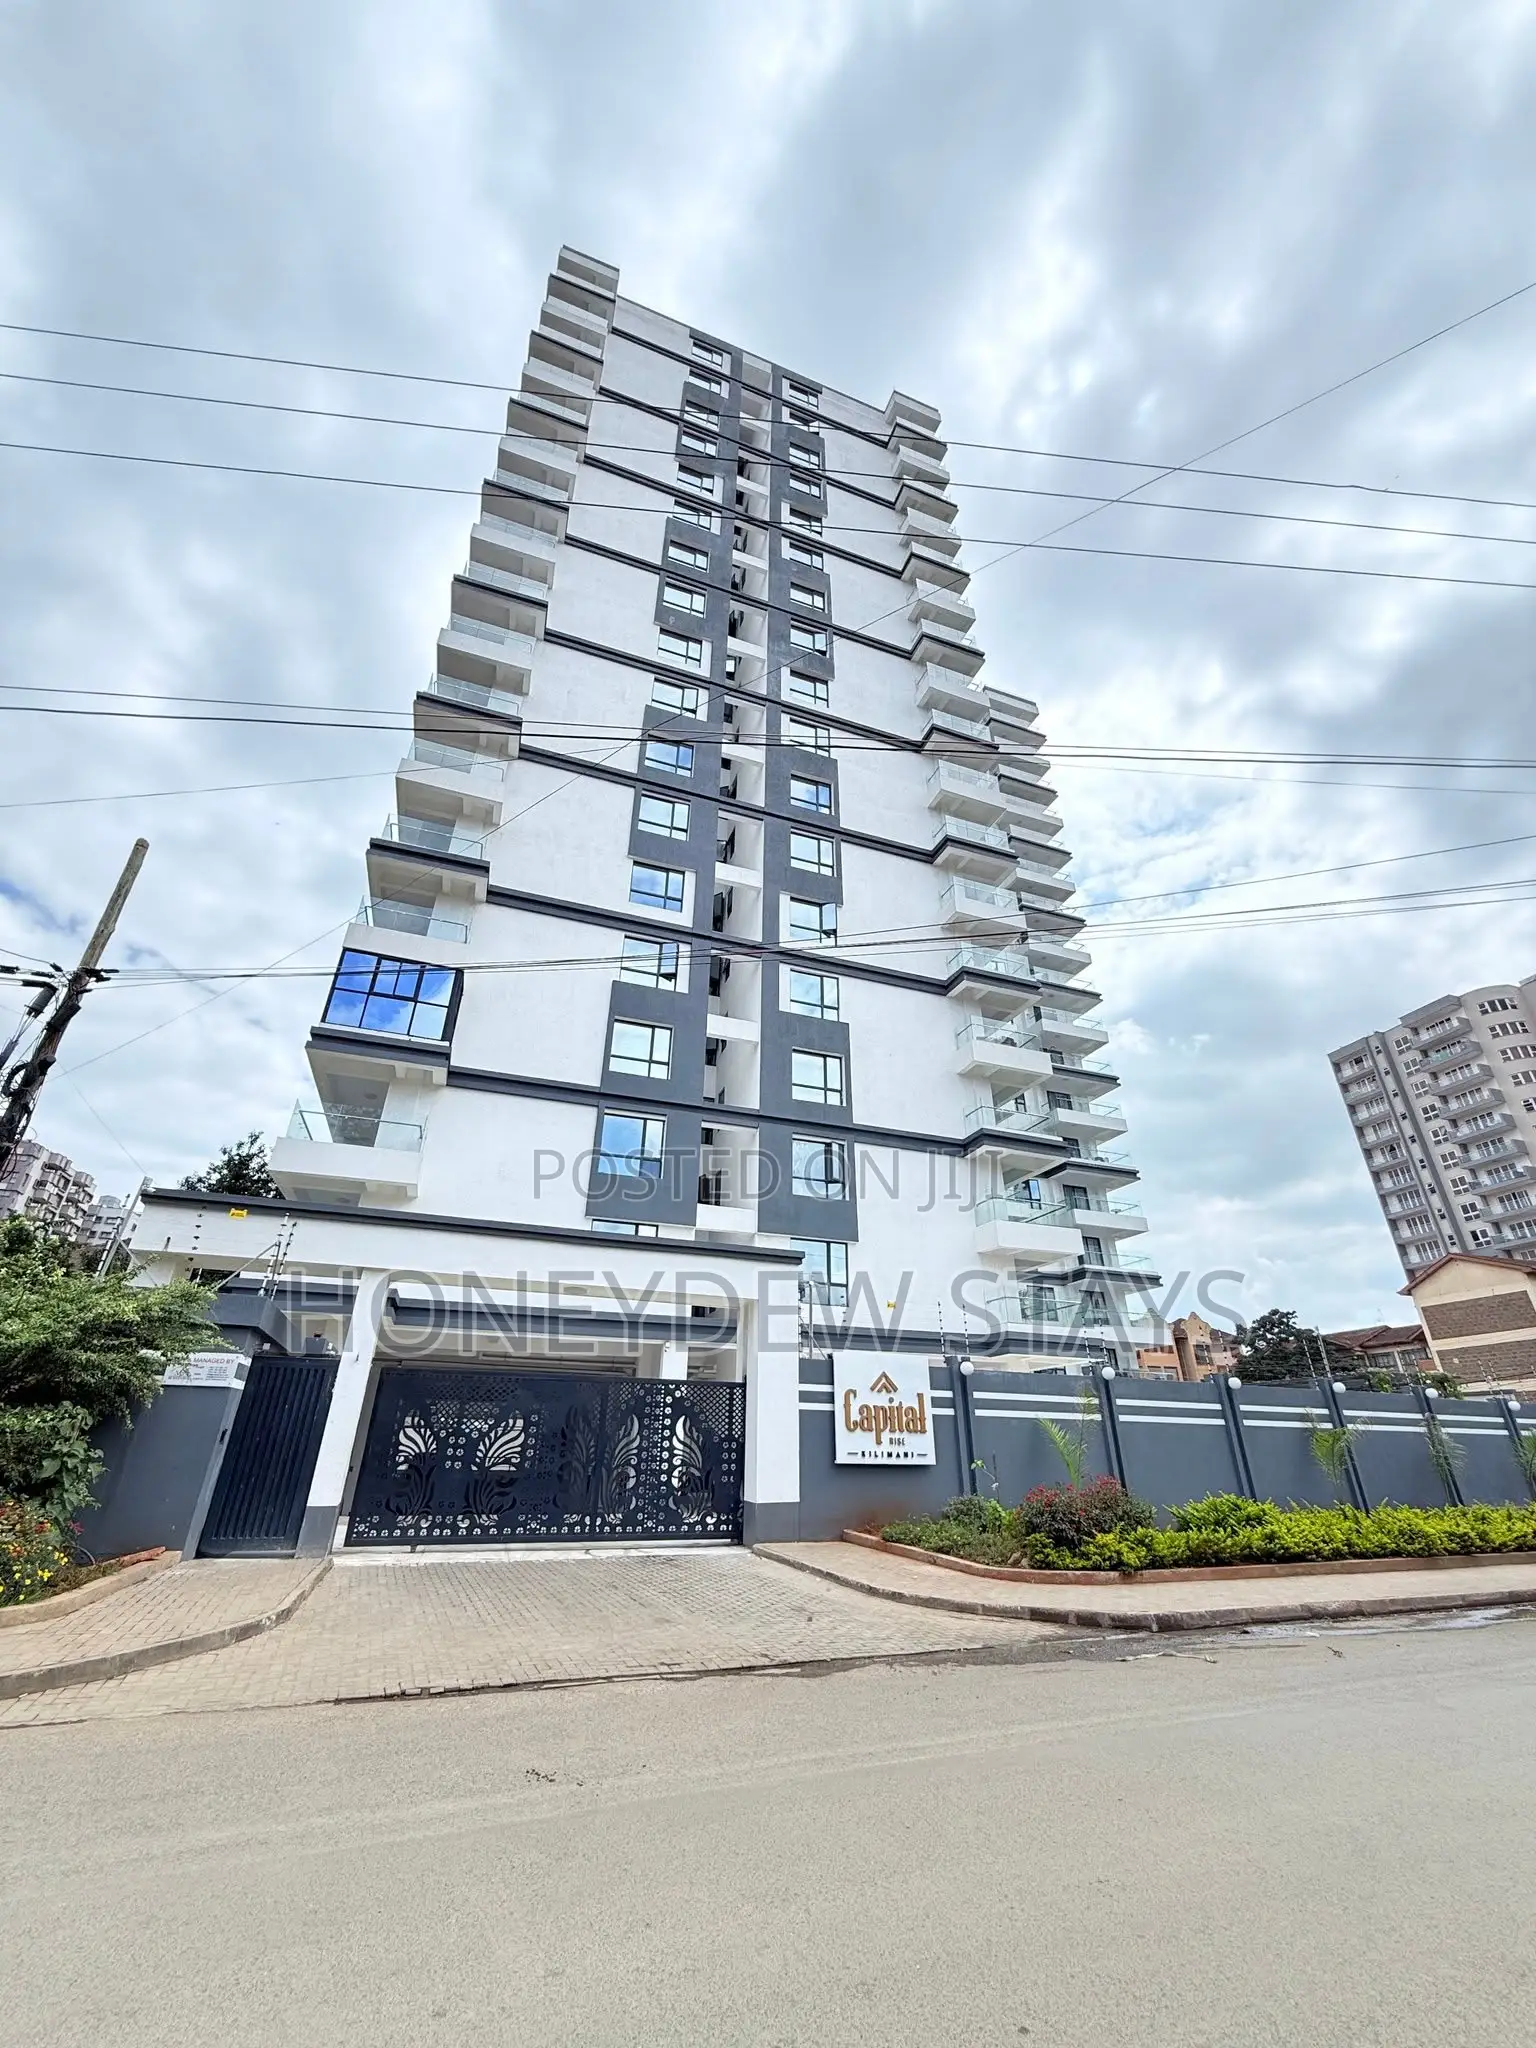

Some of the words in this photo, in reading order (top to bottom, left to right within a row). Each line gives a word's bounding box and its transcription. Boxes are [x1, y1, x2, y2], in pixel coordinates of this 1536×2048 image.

[843, 1388, 928, 1446] Capital
[888, 1437, 906, 1446] RISE
[861, 1450, 914, 1459] KILIMANI
